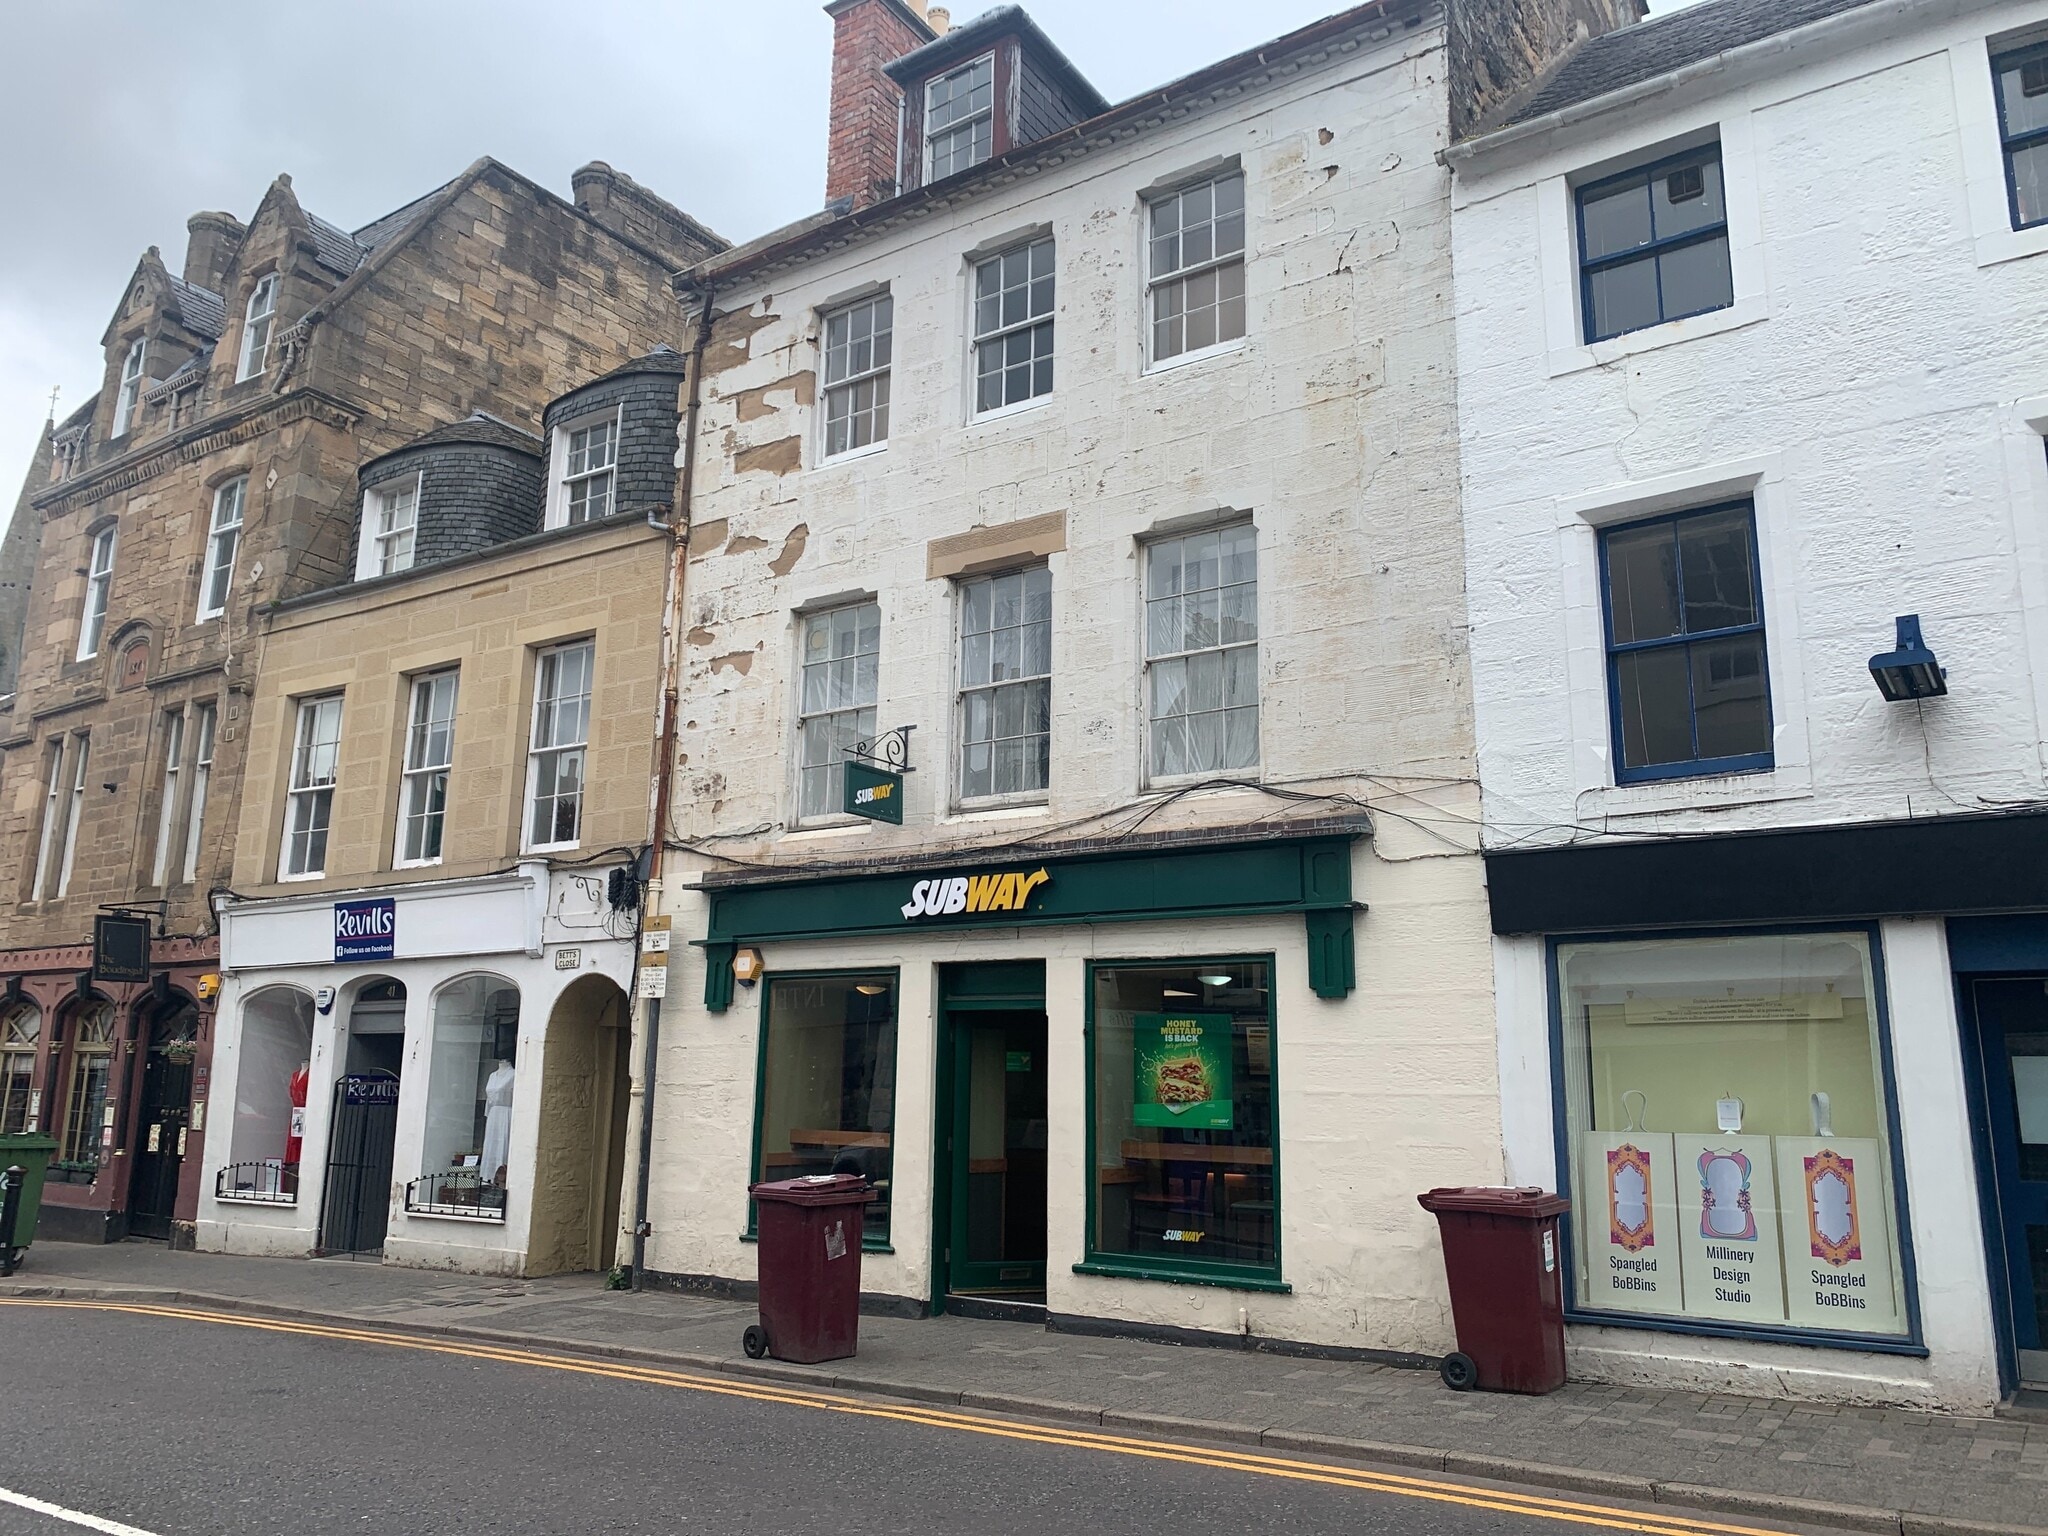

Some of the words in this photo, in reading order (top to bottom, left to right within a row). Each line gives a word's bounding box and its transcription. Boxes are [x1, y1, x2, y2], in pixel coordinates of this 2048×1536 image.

[855, 783, 894, 804] SUBWAY
[901, 867, 1049, 920] SUBWAY
[336, 907, 393, 937] Revills
[99, 954, 114, 963] The
[559, 960, 576, 968] CLOSE
[386, 985, 396, 997] 41
[1160, 1027, 1203, 1035] MUSTARD
[1164, 1034, 1174, 1042] IS
[1174, 1034, 1199, 1042] BACK
[1162, 1229, 1205, 1242] SUBWAY
[1706, 1245, 1754, 1263] Millinery
[1609, 1255, 1657, 1273] Spangled
[1612, 1275, 1656, 1292] BoBBins
[1713, 1266, 1750, 1284] Design
[1811, 1269, 1866, 1288] Spangled
[1715, 1287, 1751, 1303] Studio
[1815, 1291, 1866, 1309] BoBBins
